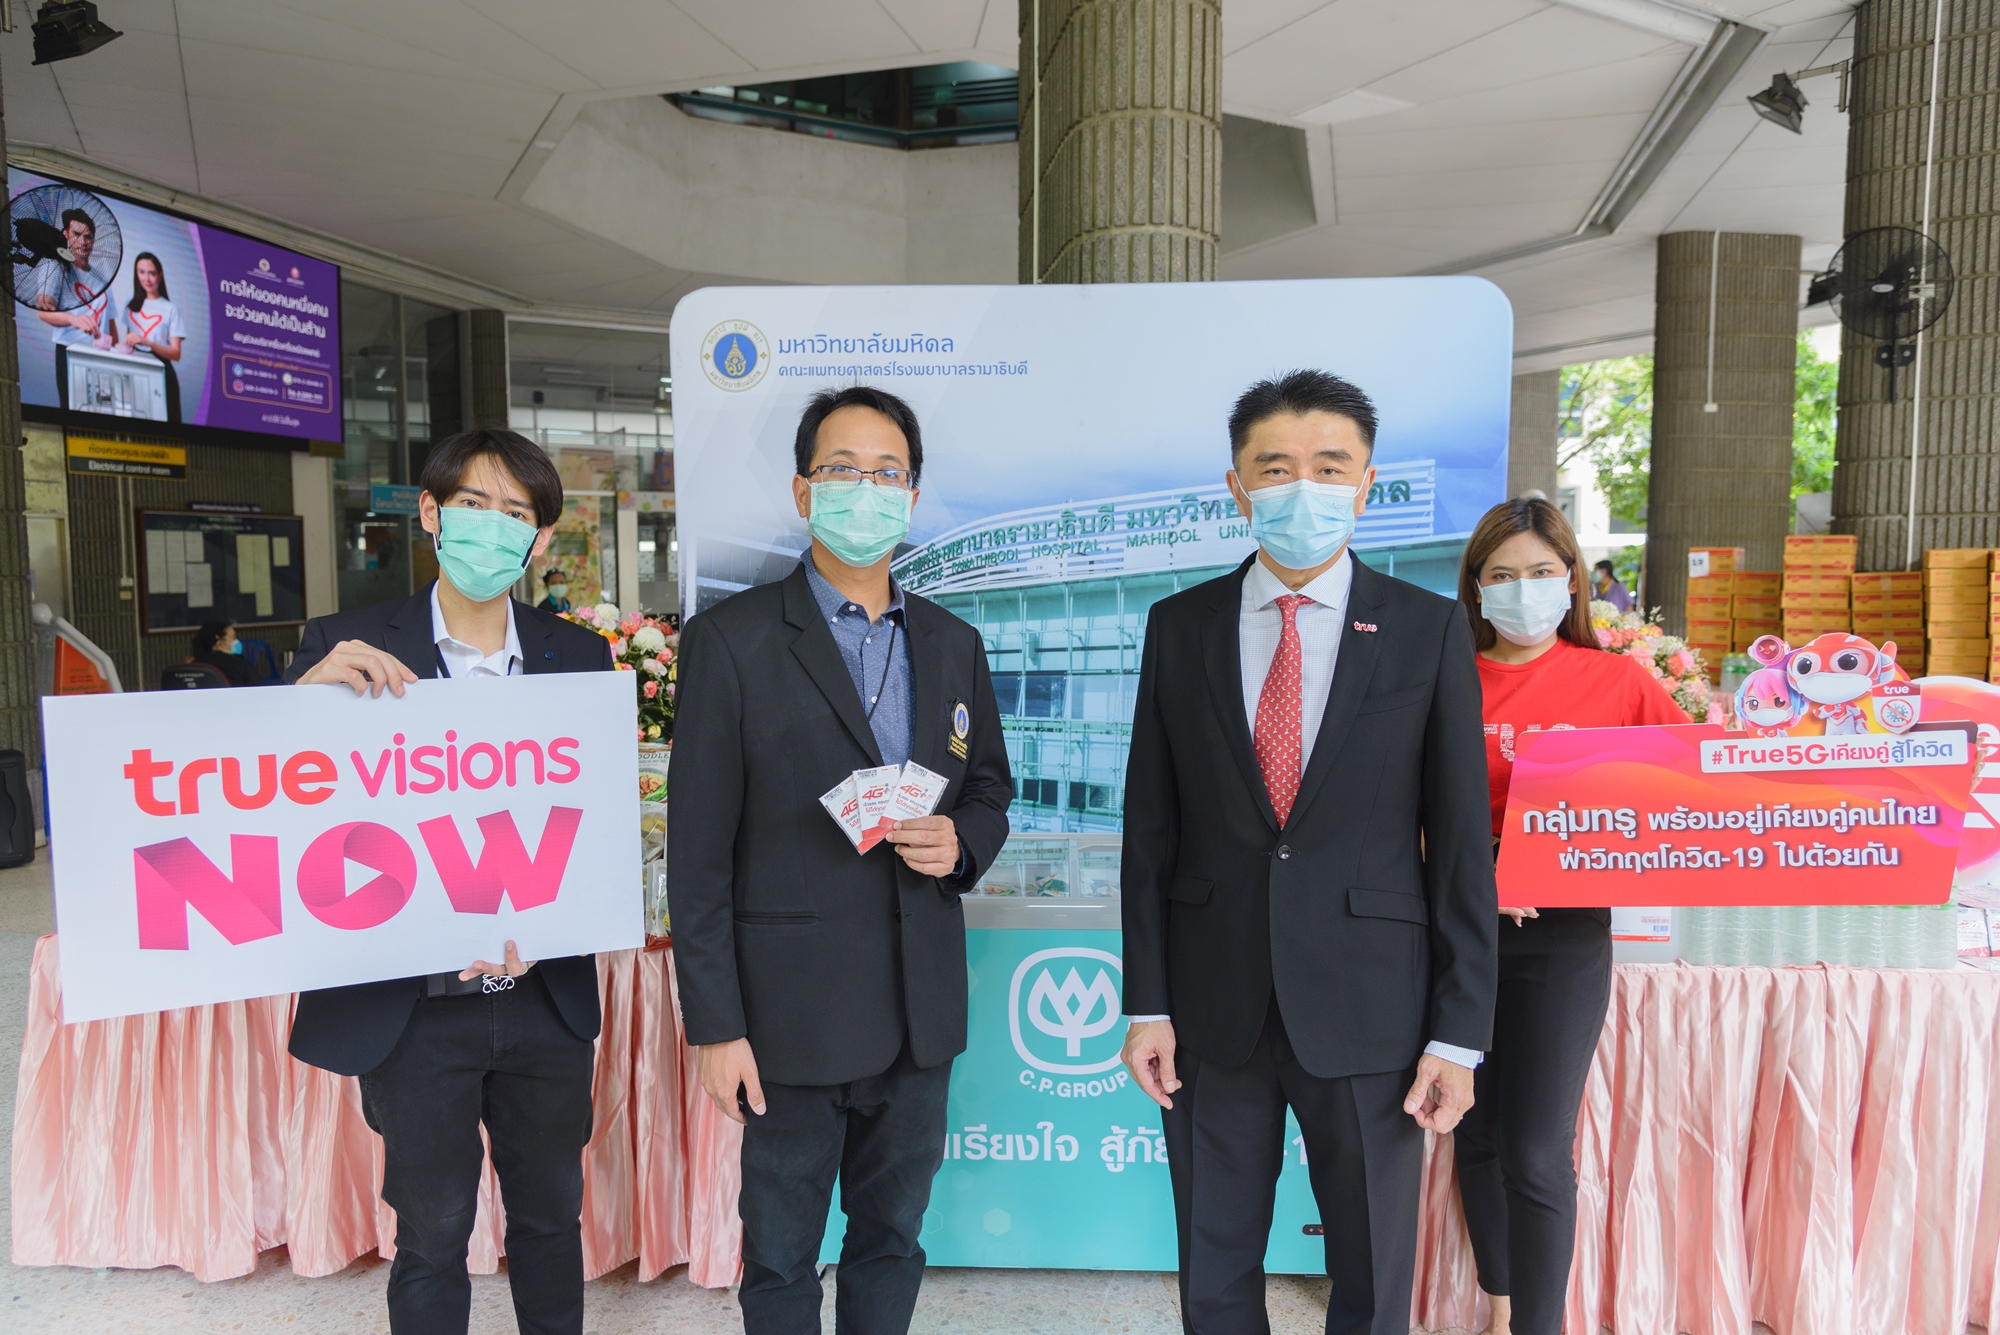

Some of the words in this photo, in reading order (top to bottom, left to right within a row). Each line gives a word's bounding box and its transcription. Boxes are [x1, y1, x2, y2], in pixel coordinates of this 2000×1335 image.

[220, 279, 329, 318] การให้ของคนหนึ่งคน
[224, 303, 326, 338] จะช่วยคนได้เป็นล้าน
[778, 333, 954, 354] มหาวิทยาลัยมหิดล
[778, 361, 1028, 377] คณะแพทยศาสตร์โรงพยาบาลรามาธิบดี
[88, 460, 124, 472] Electrical
[125, 463, 151, 475] control
[152, 466, 171, 476] room
[951, 548, 1018, 573] RAMATHIBODI
[1126, 528, 1201, 547] MAHIDOL
[1353, 621, 1378, 633] true
[1882, 684, 1910, 695] true
[124, 748, 339, 817] true
[350, 730, 581, 798] visions
[1523, 801, 1637, 840] กลุ่มทรู
[1648, 797, 1937, 835] พร้อมอยู่เคียงคู่คนไทย
[1559, 844, 1764, 873] ฝ่าวิกฤตโควิด-19
[1772, 841, 1898, 867] ไปด้วยกัน
[133, 805, 584, 951] NOW
[1019, 1069, 1128, 1098] C.P.GROUP
